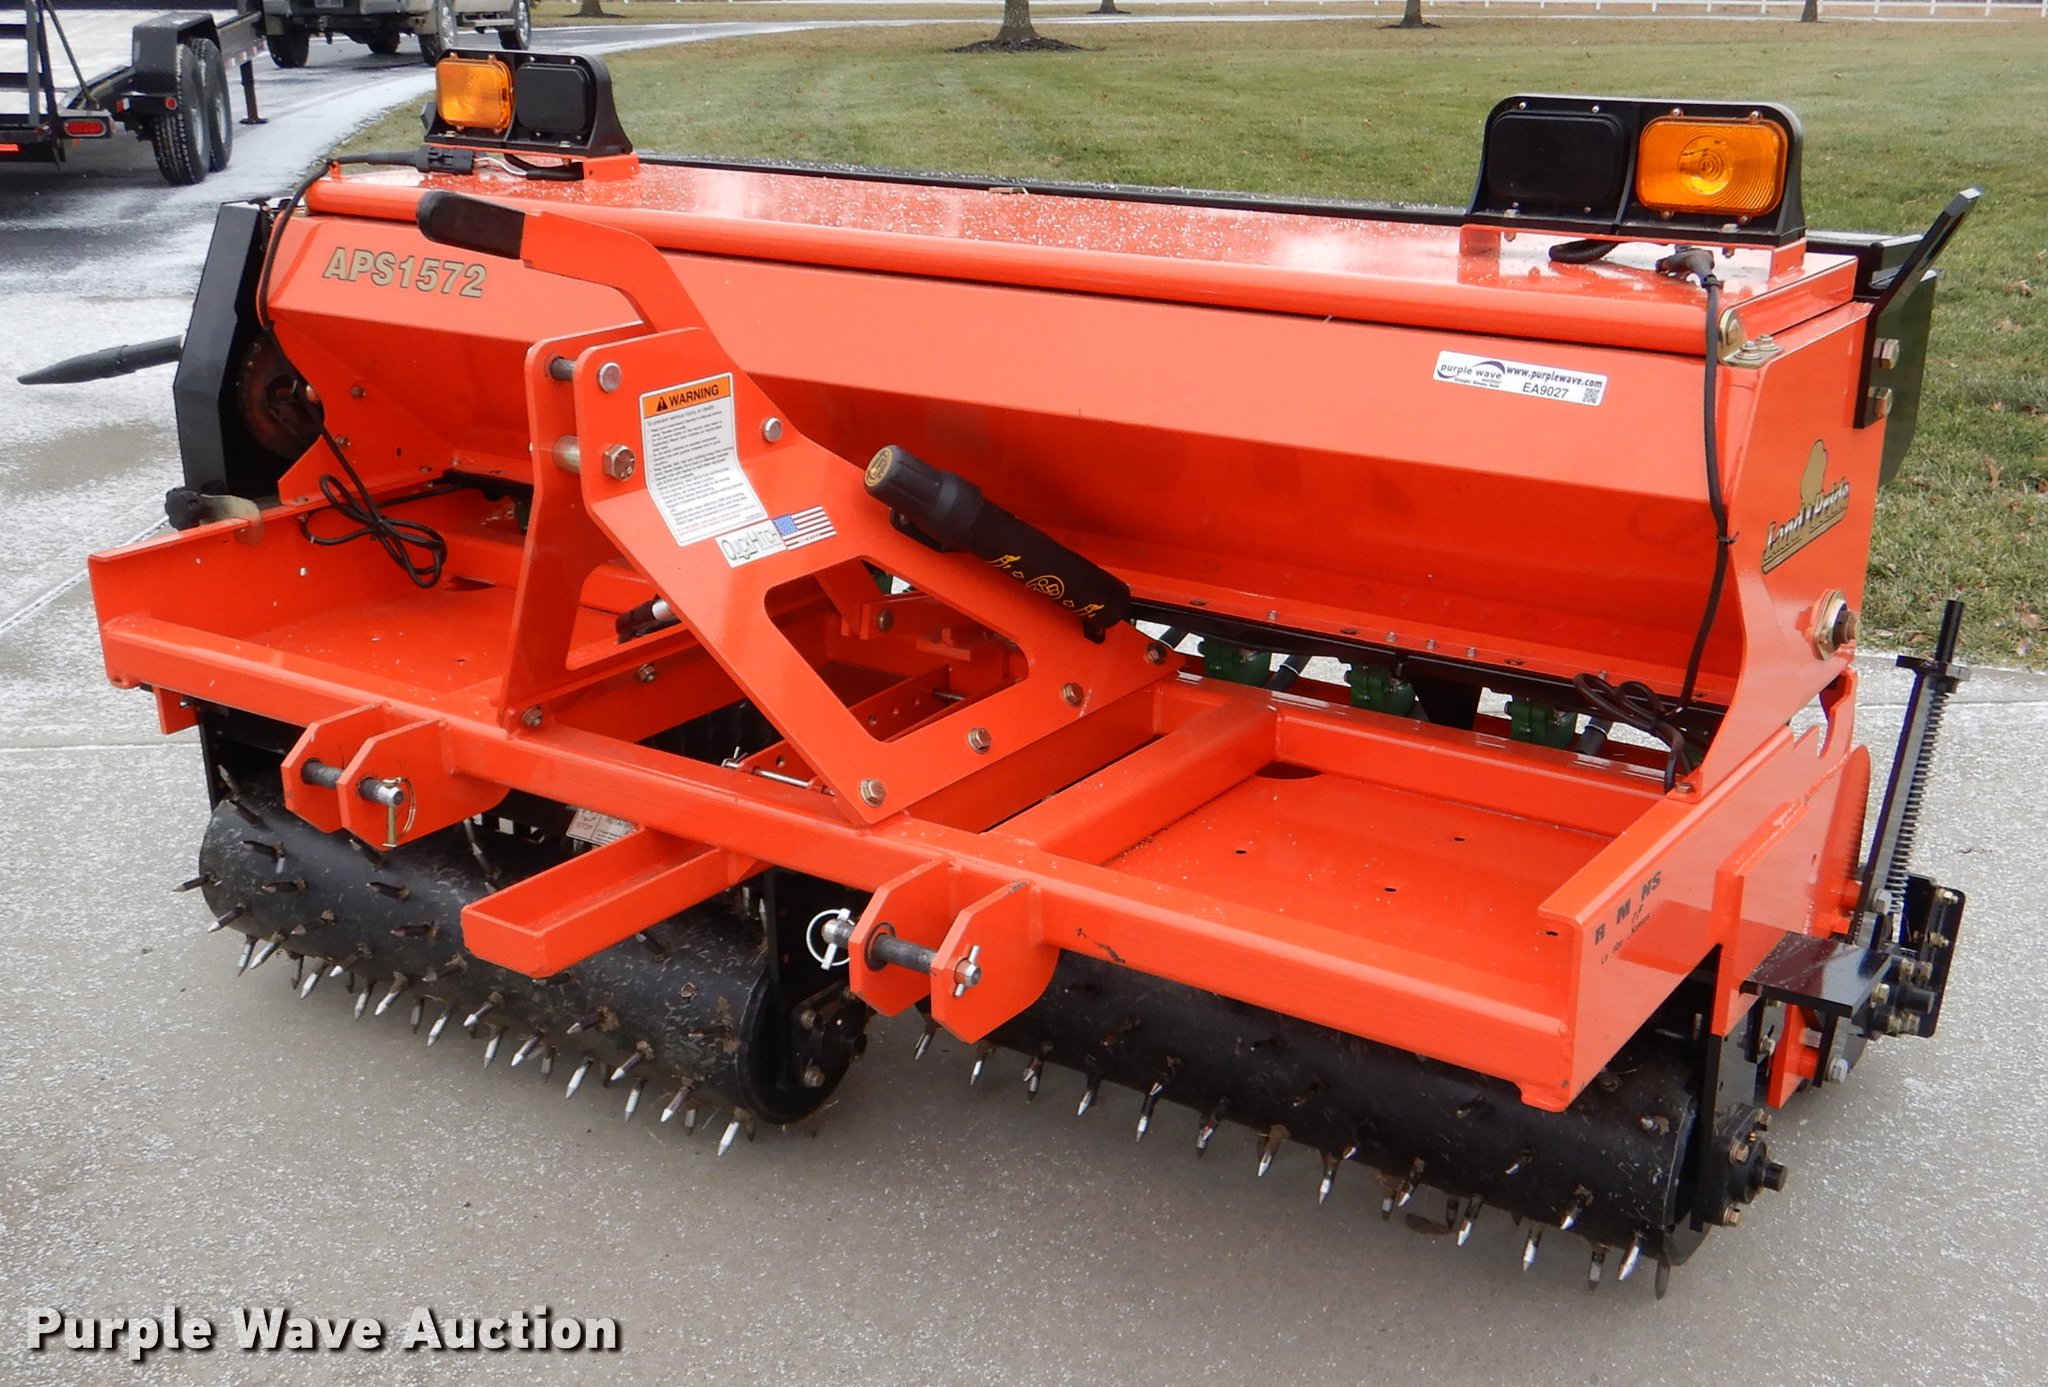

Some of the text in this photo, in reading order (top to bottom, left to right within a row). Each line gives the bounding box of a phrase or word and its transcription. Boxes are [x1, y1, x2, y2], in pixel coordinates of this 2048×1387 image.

[322, 246, 488, 299] APS1572
[1440, 364, 1502, 380] purple wave
[1506, 366, 1603, 389] www.purplewave.com
[668, 384, 719, 407] WARNING
[1522, 382, 1569, 399] EA9027
